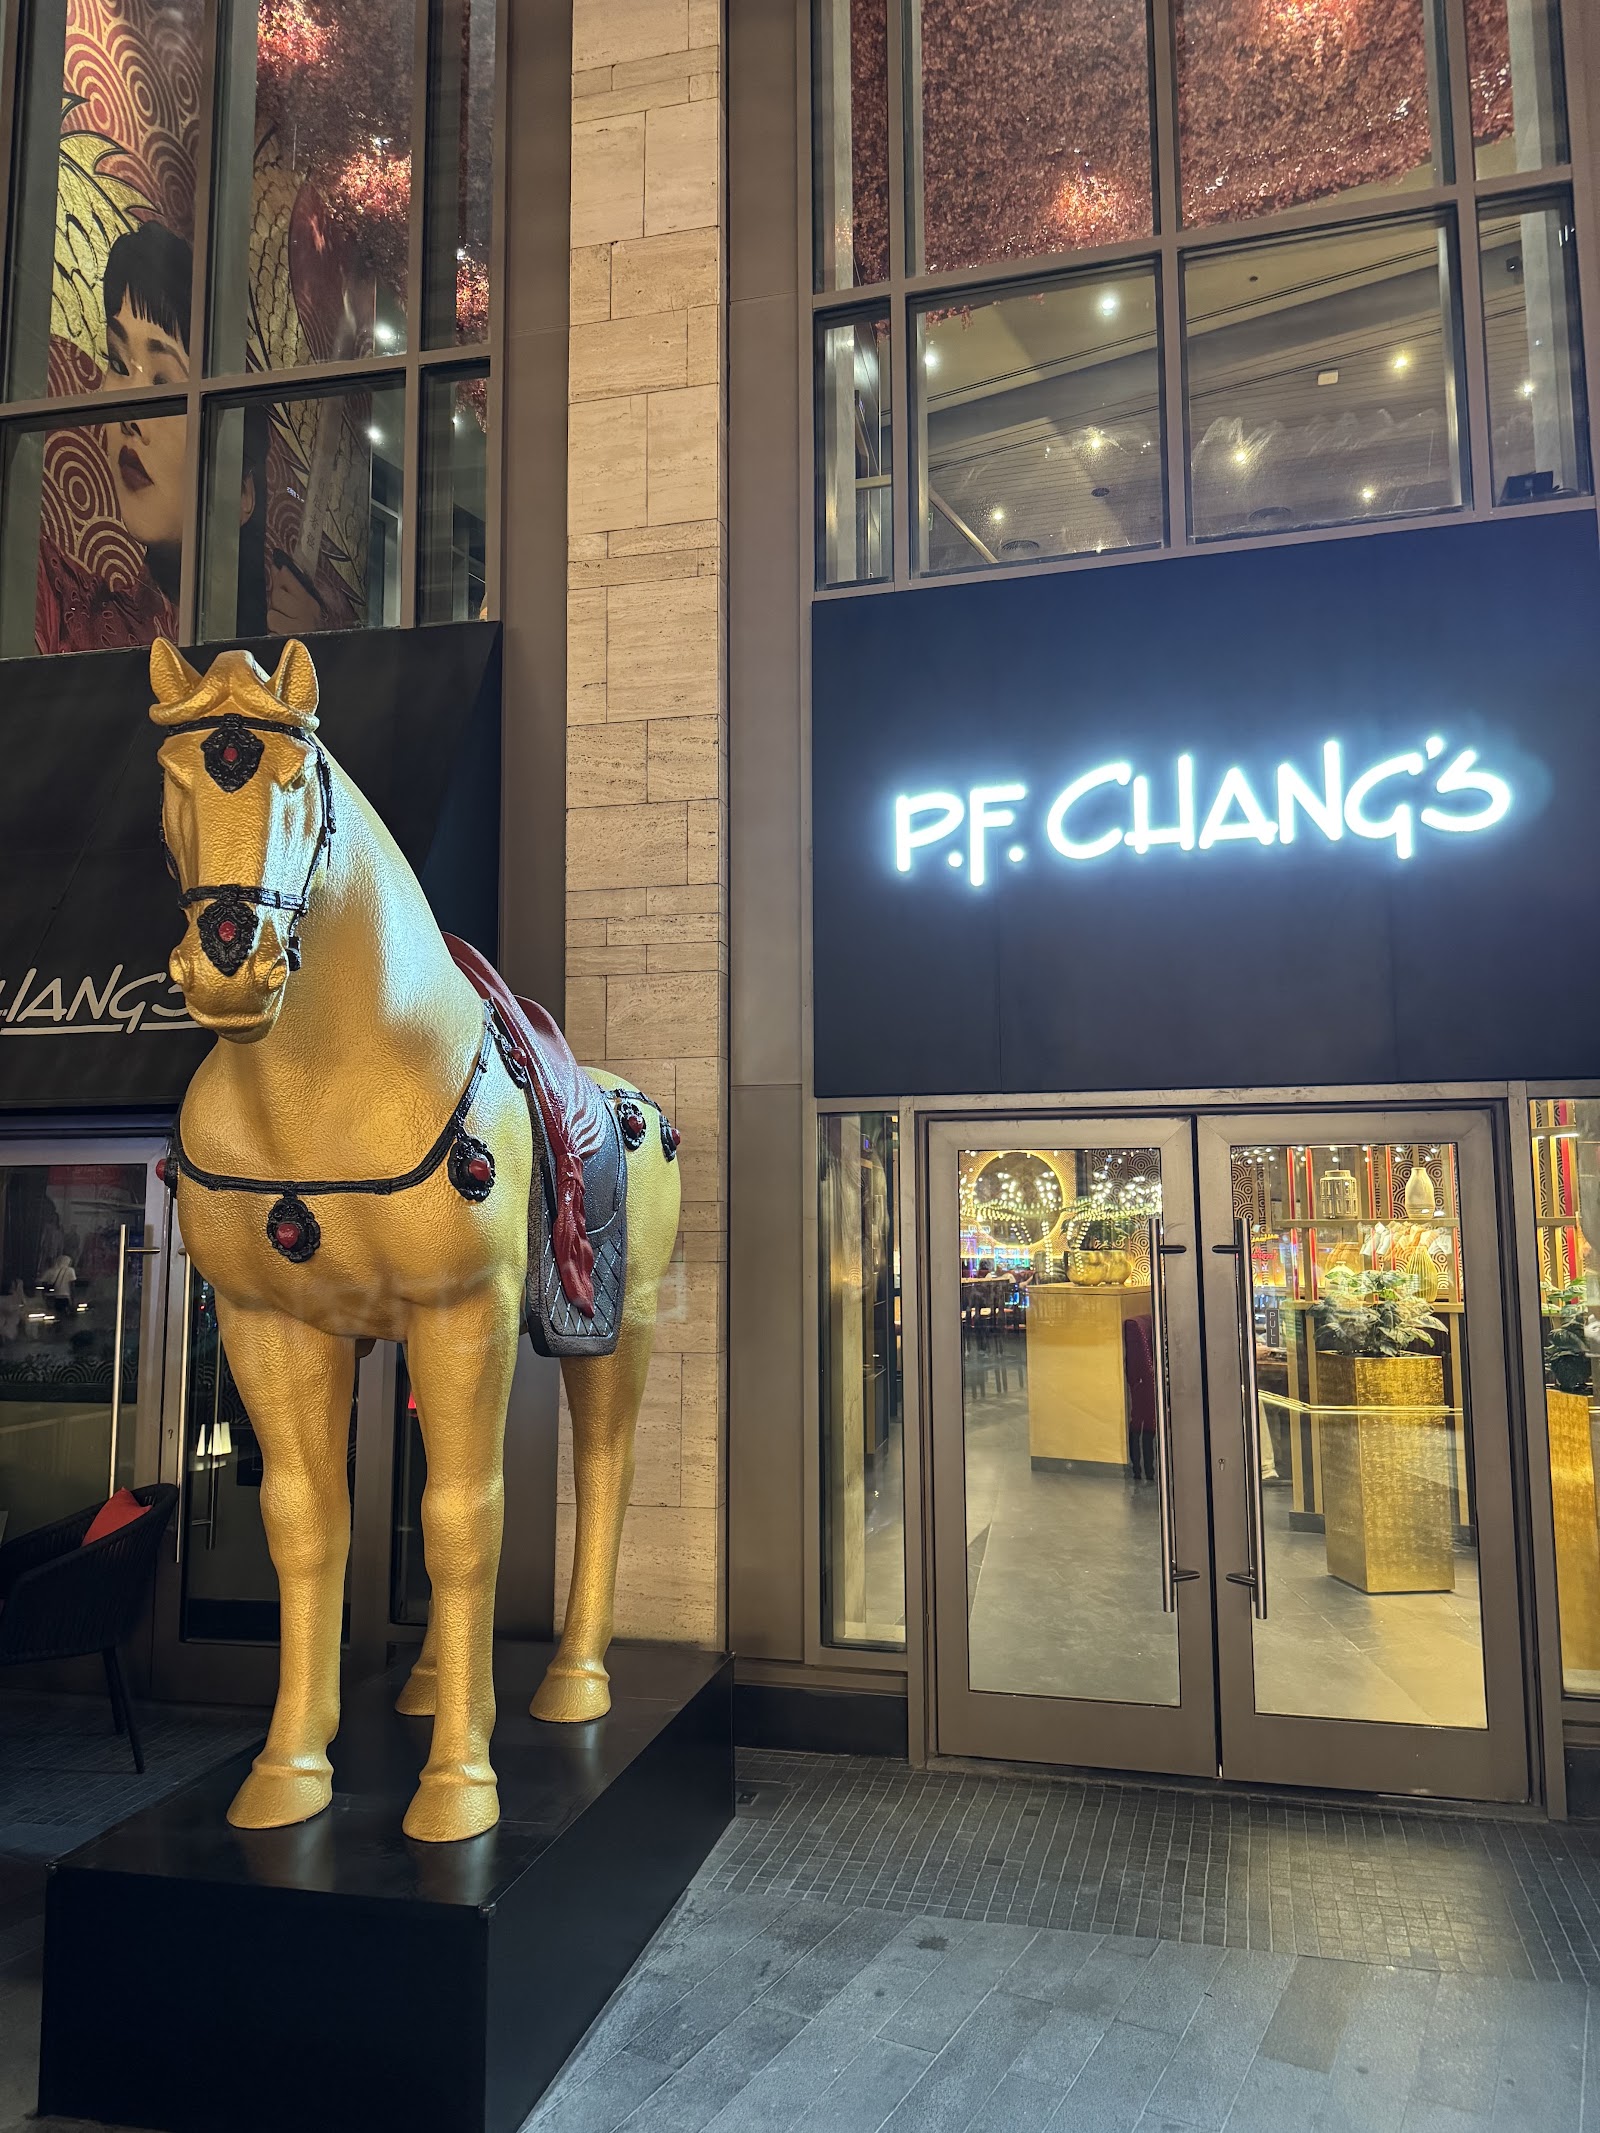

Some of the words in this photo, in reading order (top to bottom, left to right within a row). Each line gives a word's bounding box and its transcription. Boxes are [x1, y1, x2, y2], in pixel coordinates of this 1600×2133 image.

[894, 783, 1027, 888] P.F.
[1045, 736, 1513, 861] CHANG'S
[1269, 1311, 1277, 1345] PULL
